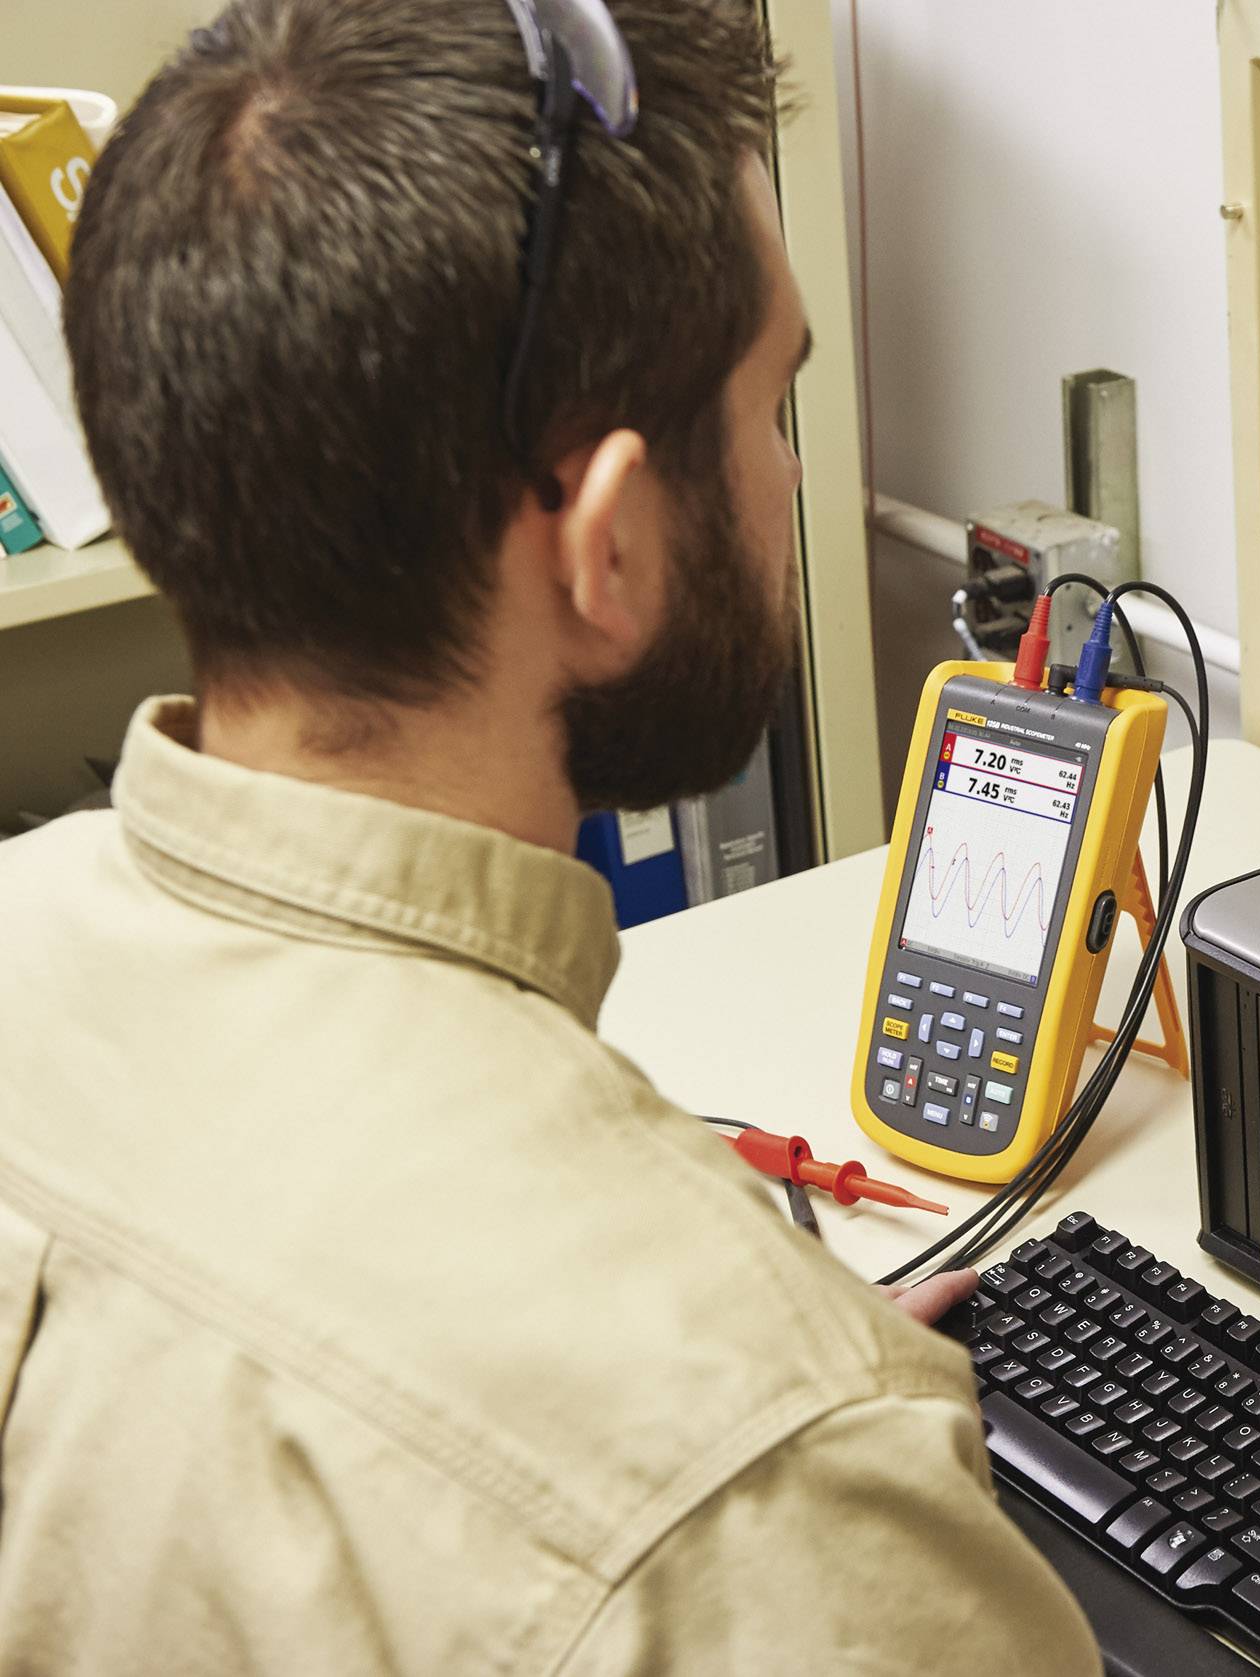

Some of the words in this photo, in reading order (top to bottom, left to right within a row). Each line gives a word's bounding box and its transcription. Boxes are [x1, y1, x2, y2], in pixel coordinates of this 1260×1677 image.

[1016, 705, 1031, 713] COM
[955, 712, 984, 725] FLUKE
[946, 743, 952, 751] A
[974, 748, 1007, 771] 7.20
[1011, 757, 1024, 766] rms
[939, 772, 945, 780] B
[1058, 770, 1077, 781] 62.44
[968, 777, 1000, 800] 7.45
[1066, 781, 1075, 790] Hz
[1004, 787, 1017, 796] rms
[1052, 799, 1071, 810] 62.43
[1060, 810, 1069, 819] Hz
[886, 1020, 903, 1030] SCOPE
[885, 1027, 903, 1036] METER
[993, 1057, 1014, 1068] RECORD
[927, 1108, 943, 1119] MENU
[1101, 1236, 1111, 1244] F1
[1126, 1251, 1137, 1260] F2
[1151, 1267, 1162, 1276] F3
[1061, 1280, 1071, 1288] 2
[1177, 1283, 1188, 1292] F4
[1029, 1288, 1041, 1298] Q
[1087, 1295, 1097, 1303] 3
[1053, 1303, 1068, 1315] W
[1210, 1304, 1222, 1313] F5
[1001, 1316, 1014, 1324] A
[1077, 1320, 1091, 1331] E
[1237, 1320, 1249, 1330] F6
[1026, 1332, 1039, 1340] S
[1138, 1329, 1148, 1337] 5
[1102, 1337, 1116, 1348] R
[979, 1343, 993, 1353] Z
[1051, 1348, 1064, 1357] D
[1164, 1345, 1174, 1354] 6
[1130, 1353, 1143, 1362] T
[1003, 1361, 1017, 1371] X
[1076, 1365, 1090, 1374] F
[1190, 1363, 1200, 1371] 7
[1157, 1371, 1169, 1381] Y
[1030, 1379, 1042, 1388] C
[1103, 1383, 1116, 1393] G
[1218, 1381, 1228, 1389] 8
[1182, 1388, 1196, 1399] U
[1057, 1395, 1070, 1405] V
[1245, 1398, 1255, 1406] 9
[1128, 1400, 1143, 1411] H
[1080, 1413, 1094, 1423] B
[1156, 1420, 1169, 1428] J
[1239, 1426, 1251, 1436] O
[1106, 1431, 1122, 1442] N
[1182, 1436, 1197, 1447] K
[1133, 1450, 1149, 1461] M
[1210, 1455, 1221, 1465] L
